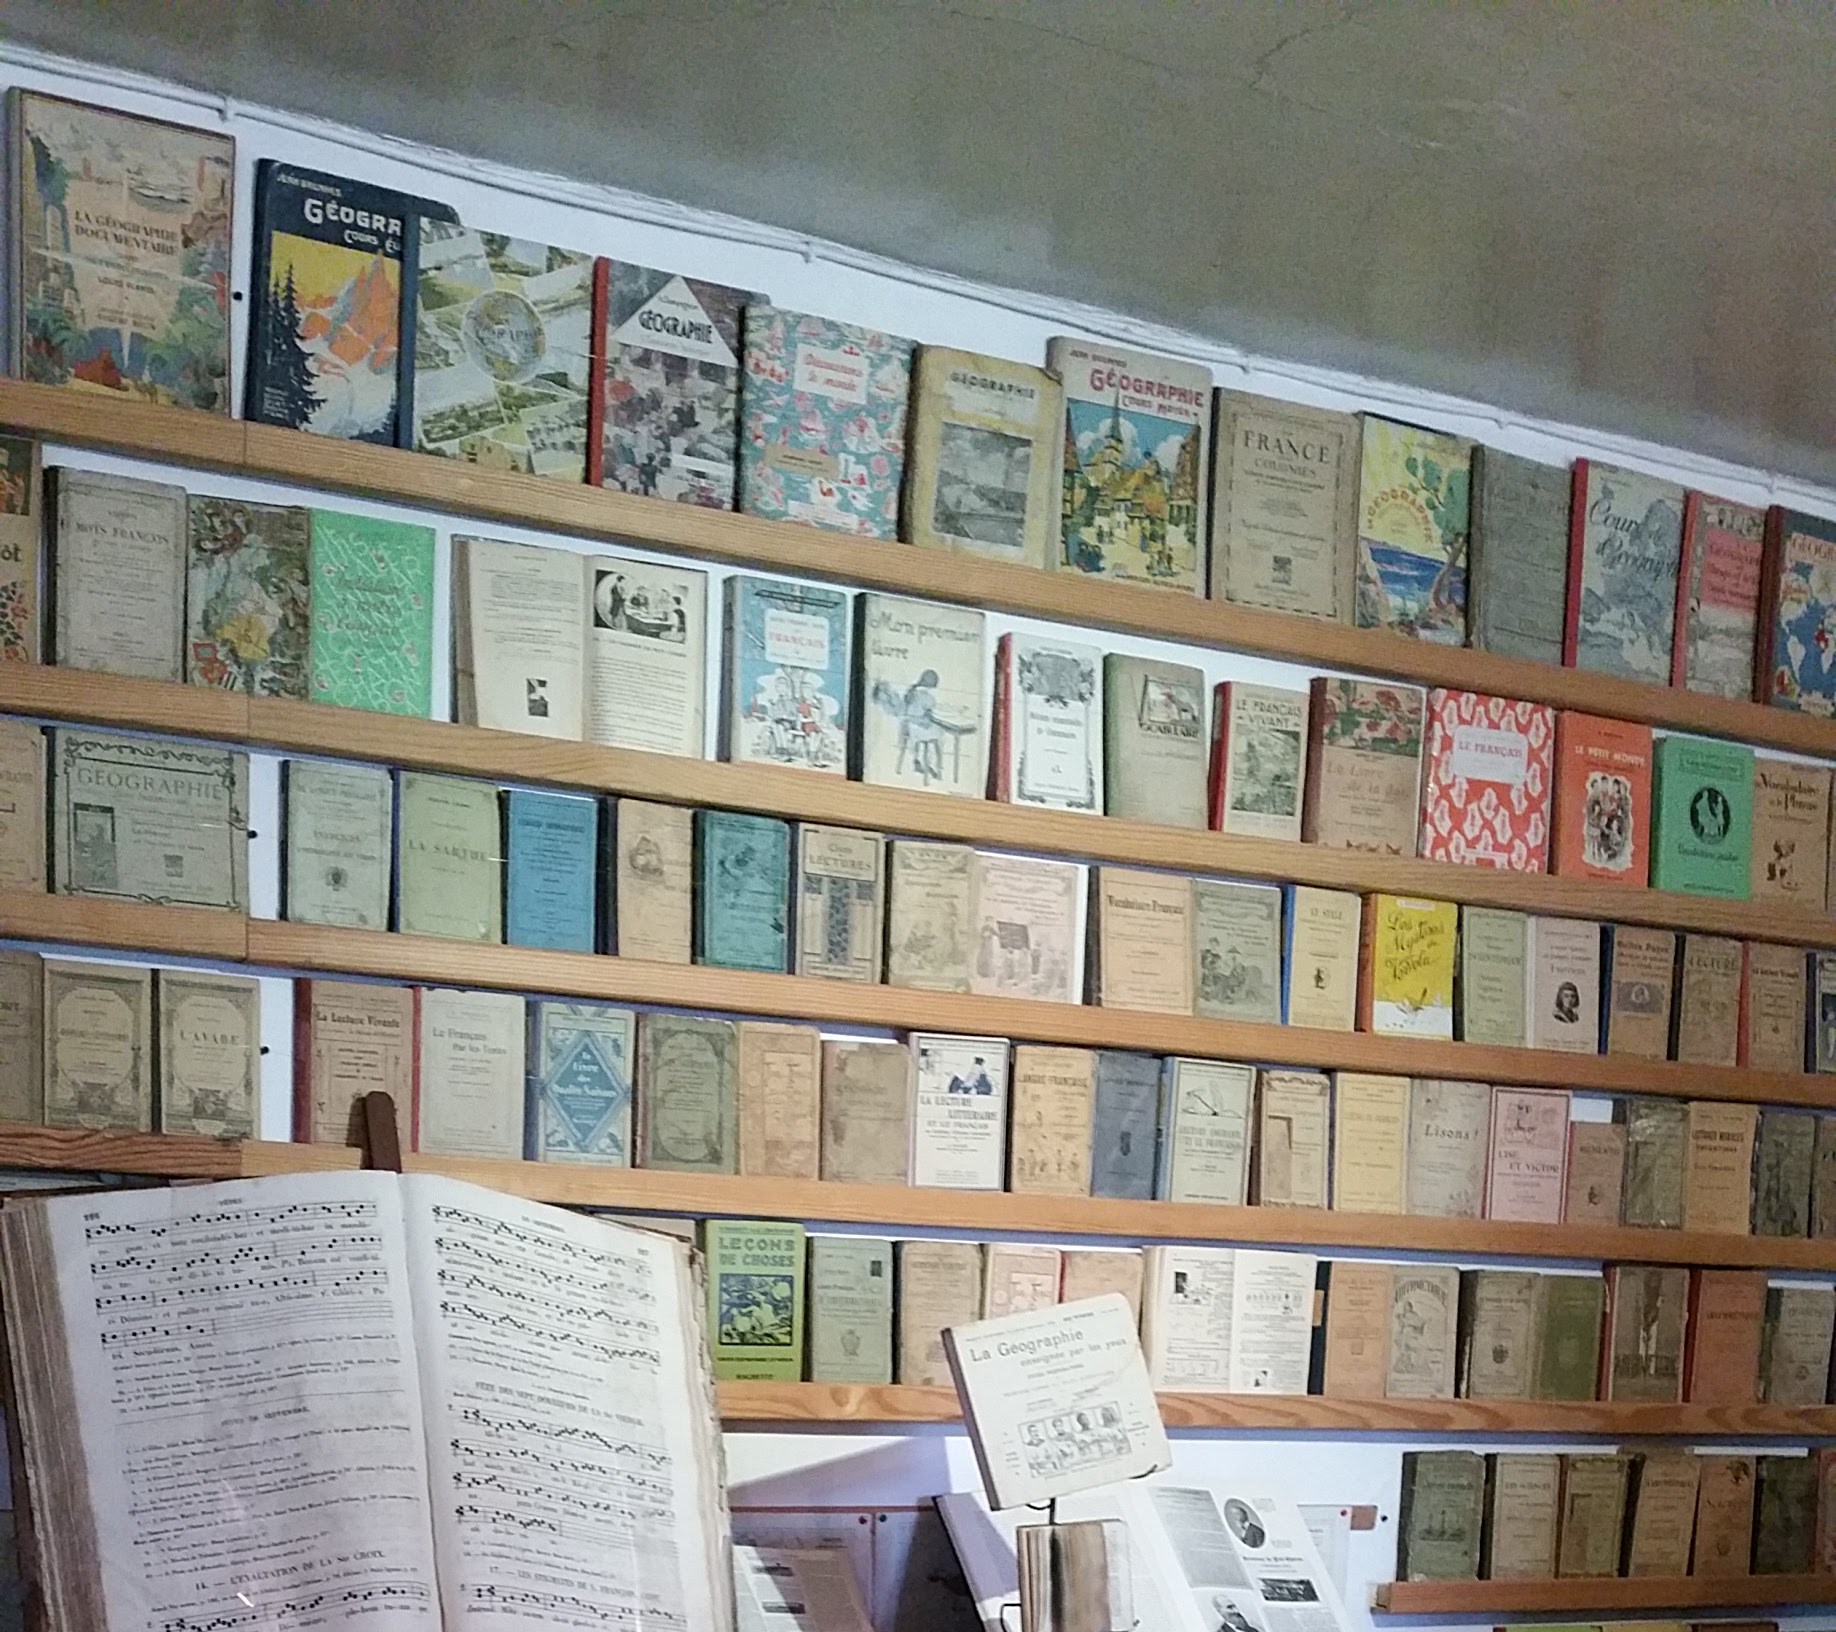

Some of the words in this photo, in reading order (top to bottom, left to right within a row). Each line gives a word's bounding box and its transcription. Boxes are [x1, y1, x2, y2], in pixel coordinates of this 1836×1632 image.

[75, 210, 92, 224] LA
[304, 197, 402, 236] GÉOGRA
[75, 225, 178, 257] DOCUMENTAIRE
[638, 308, 713, 345] GÉOGRAPHIE
[950, 370, 1036, 400] GÉOGRAPHIE
[1090, 365, 1204, 408] GÉOGRAPHIE
[1243, 428, 1331, 465] FRANCE
[1236, 697, 1252, 713] LE
[1254, 699, 1302, 722] FRANÇAIS
[1248, 711, 1292, 729] VIVANT
[1458, 740, 1474, 752] LE
[1475, 743, 1524, 760] FRANÇAIS
[1575, 744, 1586, 756] LE
[1588, 746, 1611, 760] PETIT
[1613, 750, 1646, 768] MONDE
[430, 844, 488, 862] SARTHE
[808, 856, 872, 872] LECTURES
[316, 1010, 328, 1022] La
[331, 1013, 364, 1027] Lecture
[367, 1015, 401, 1029] Vivante
[180, 1030, 241, 1046] L'AVARE
[433, 1026, 445, 1038] Le
[447, 1028, 488, 1044] Français
[1048, 1073, 1089, 1087] FRANÇAISE
[920, 1095, 932, 1105] LA
[935, 1096, 972, 1107] LECTURE
[1425, 1124, 1469, 1141] Lisons
[1498, 1151, 1518, 1159] LISE
[1509, 1163, 1521, 1171] ET
[1525, 1164, 1560, 1174] VICTOR
[718, 1237, 795, 1252] LEÇONS
[720, 1253, 737, 1266] DE
[743, 1254, 796, 1267] CHOSES
[968, 1338, 992, 1363] La
[1069, 1346, 1085, 1359] par
[1106, 1338, 1127, 1352] yeux
[353, 1549, 386, 1561] CROIX
